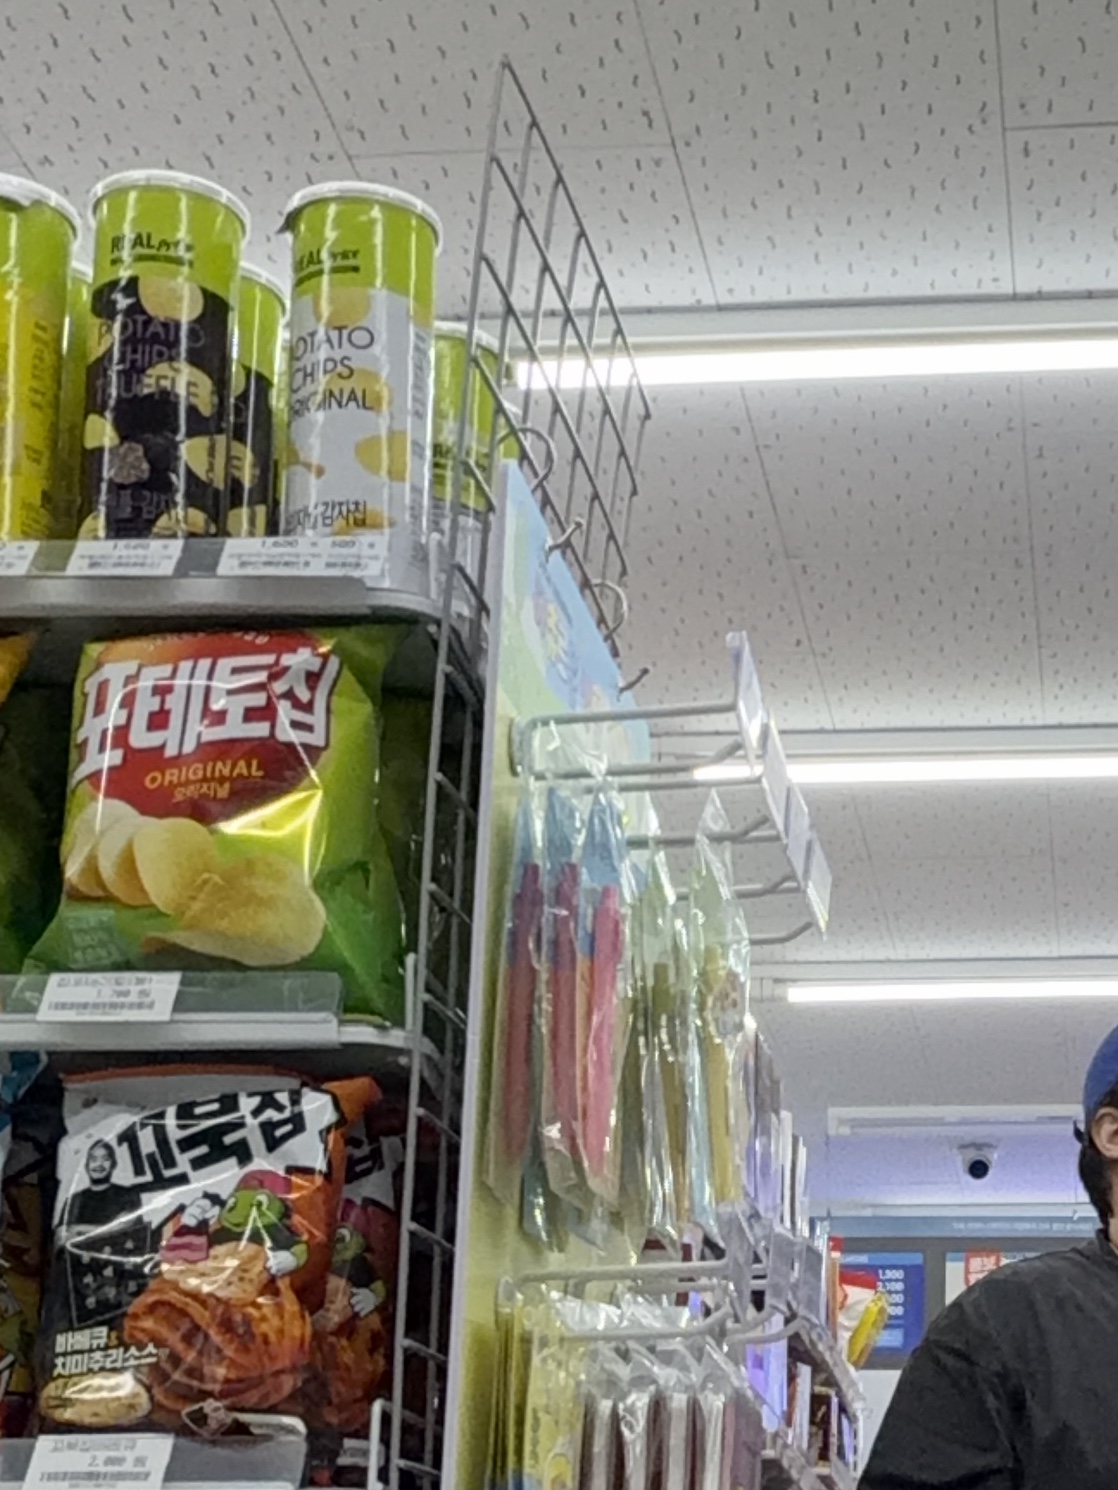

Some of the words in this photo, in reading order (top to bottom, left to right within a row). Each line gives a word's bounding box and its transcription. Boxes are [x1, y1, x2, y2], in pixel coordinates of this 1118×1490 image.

[292, 325, 375, 362] OTATO
[290, 356, 355, 394] CHIPS
[71, 647, 340, 790] 포테토칩
[144, 758, 264, 790] ORIGINAL
[53, 1342, 157, 1377] 치미추리소스
